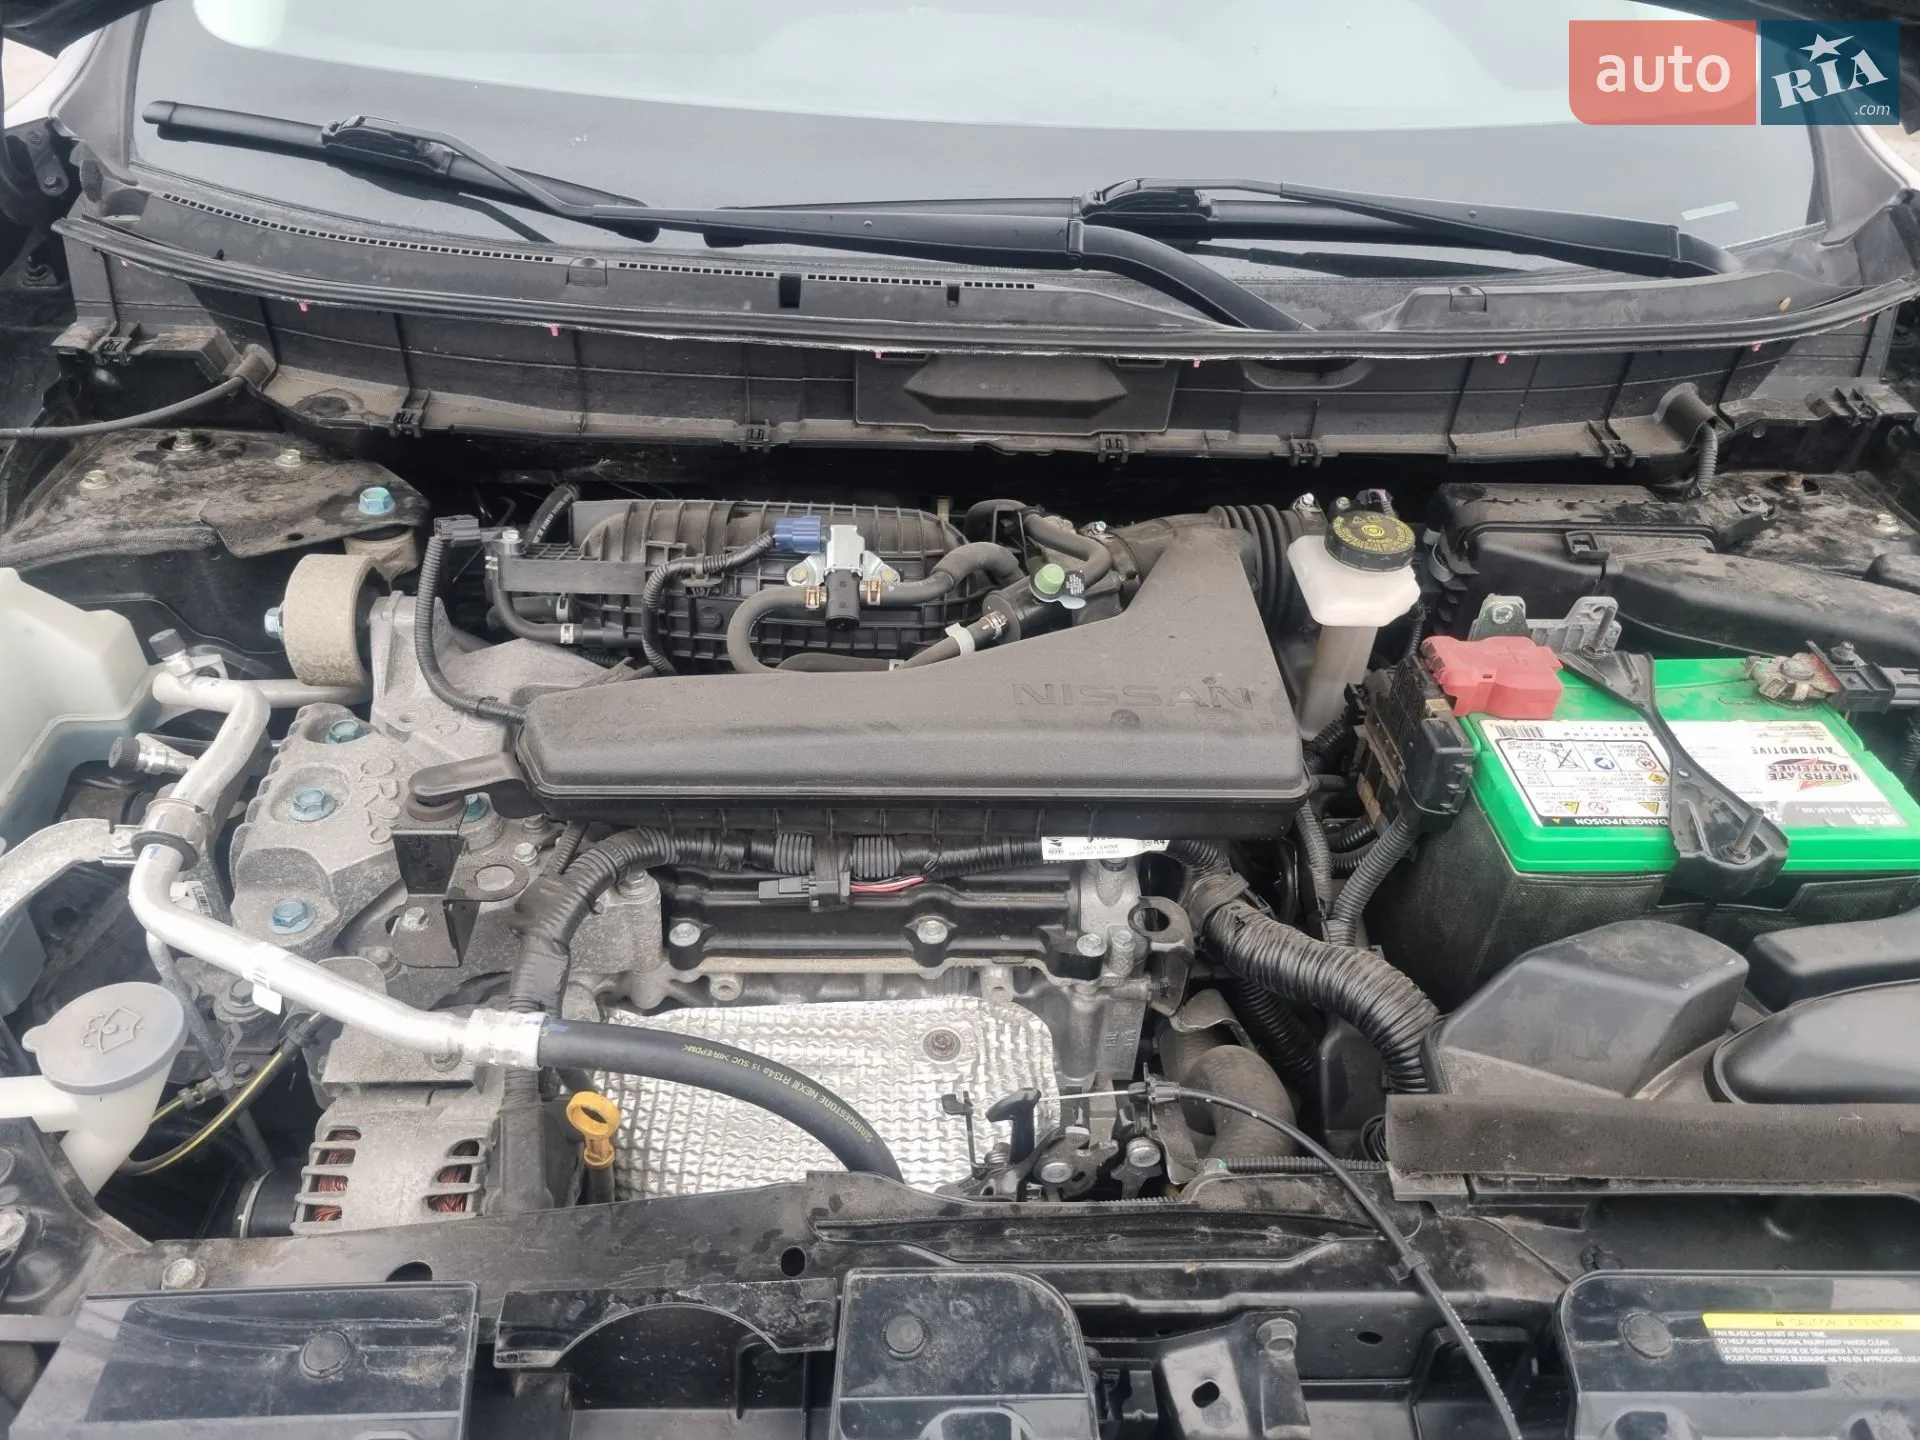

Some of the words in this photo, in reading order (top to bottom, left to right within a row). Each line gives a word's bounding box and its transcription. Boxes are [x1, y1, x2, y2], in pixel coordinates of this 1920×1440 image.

[1011, 682, 1254, 710] NISSAN
[1751, 745, 1834, 755] AUTOMOTIVE
[1768, 763, 1849, 772] BATTERIES
[1769, 772, 1860, 781] INTERSTATE
[1574, 817, 1669, 827] DANGER/POISON
[731, 1056, 750, 1068] SUC
[763, 1067, 792, 1085] R134a
[819, 1094, 874, 1142] BRIDGESTONE
